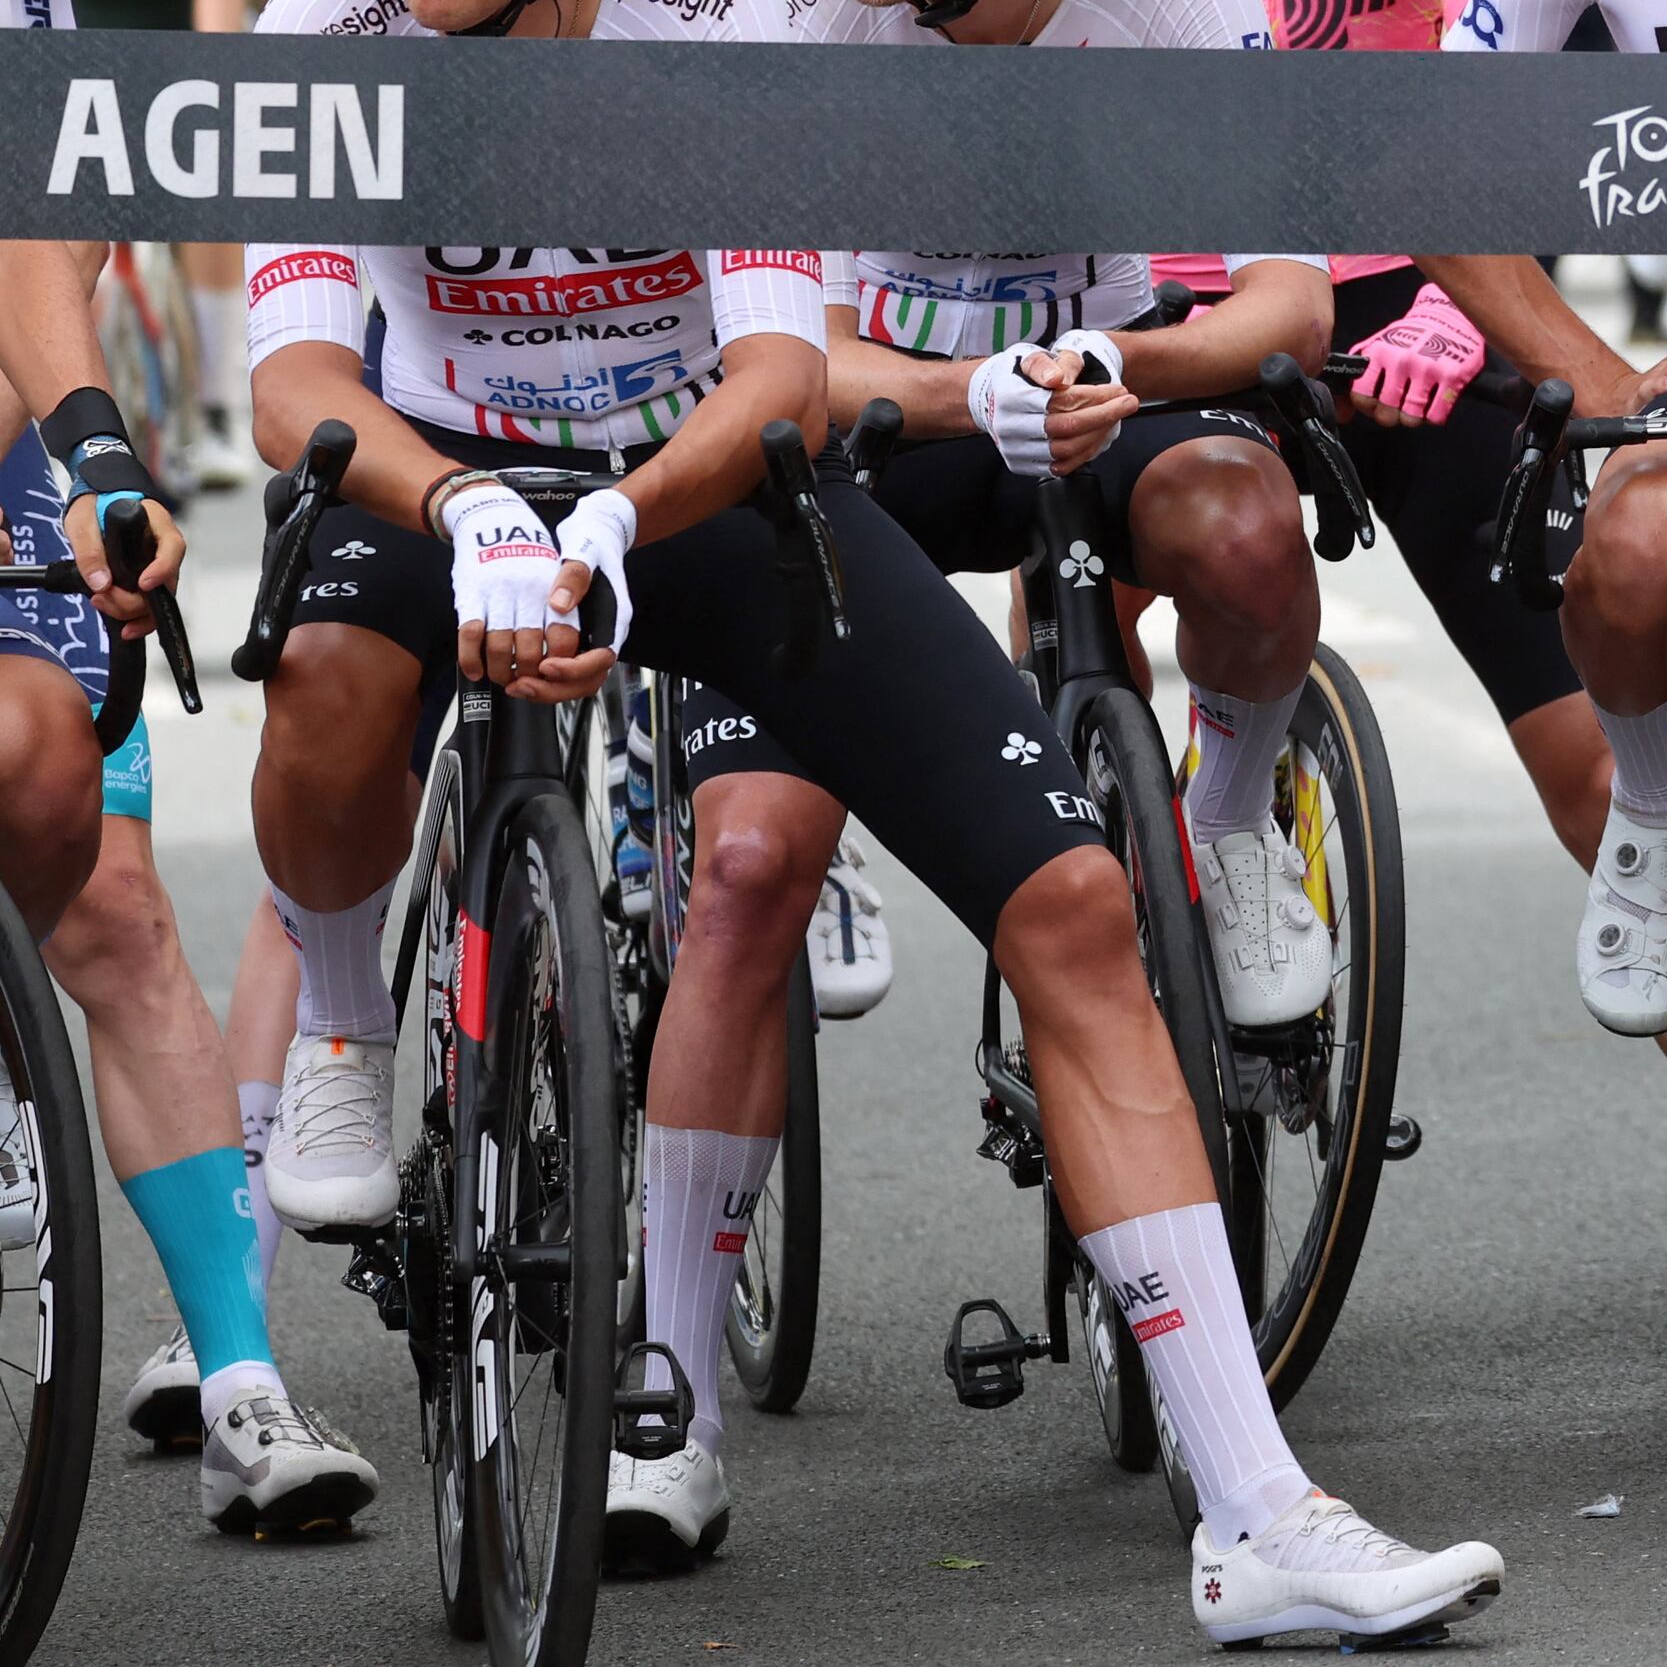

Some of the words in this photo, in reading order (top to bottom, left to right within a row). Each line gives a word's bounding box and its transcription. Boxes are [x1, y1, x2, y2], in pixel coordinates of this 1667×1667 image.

[47, 79, 404, 200] AGEN
[249, 252, 358, 301] Emirates
[437, 261, 691, 314] Emirates
[501, 314, 682, 346] COLNAGO
[486, 390, 612, 412] ADNOC
[523, 489, 576, 501] wahoo
[475, 525, 553, 548] UAE
[103, 768, 139, 782] Bapco
